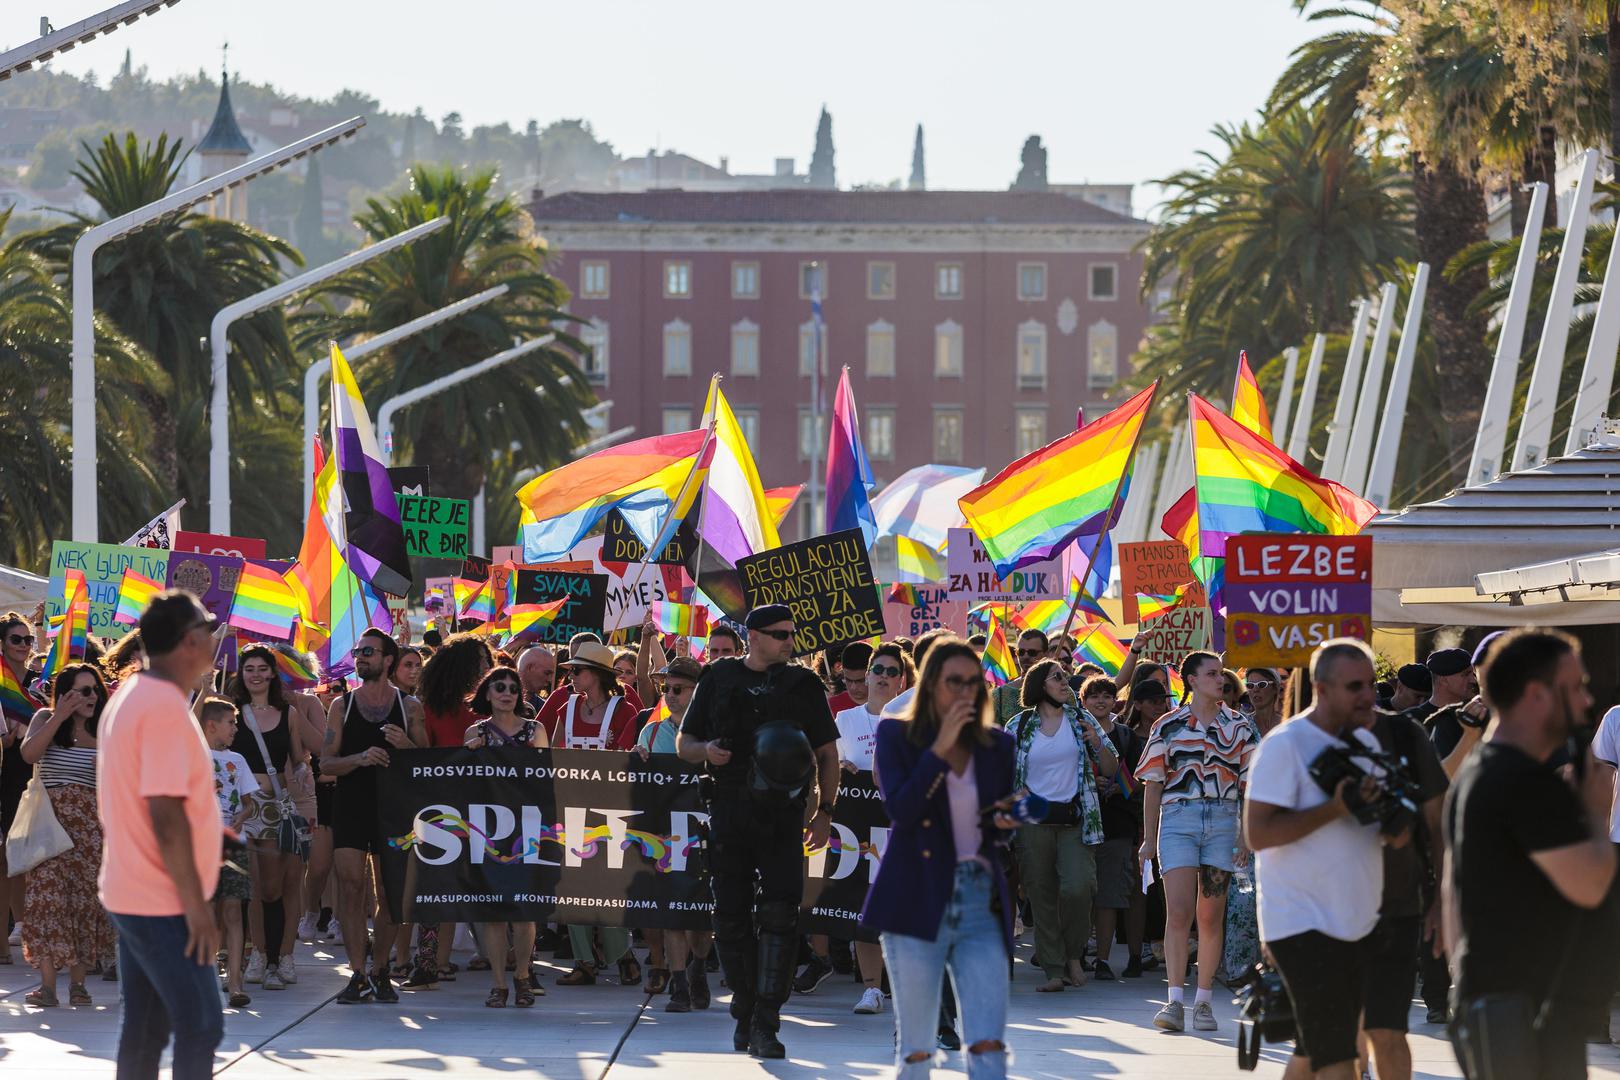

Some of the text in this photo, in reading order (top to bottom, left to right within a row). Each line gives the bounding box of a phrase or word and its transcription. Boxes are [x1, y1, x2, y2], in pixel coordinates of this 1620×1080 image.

[400, 499, 466, 525] EER JE
[745, 538, 860, 587] REGULACIJU
[1237, 544, 1367, 580] LEZBE,
[533, 574, 592, 597] SVAKA
[748, 562, 871, 609] ZDRAVSTVENE
[949, 571, 1060, 594] ZA HAJDUKA
[826, 590, 856, 616] ZA
[1249, 588, 1338, 615] VOLIN
[819, 609, 885, 643] OSOBE
[412, 765, 518, 778] PROSVJEDNA
[525, 767, 601, 781] POVORKA
[608, 771, 673, 785] LGBTIQ+
[680, 774, 700, 785] ZA
[413, 804, 644, 869] SPLIT
[416, 894, 503, 903] #MASUPONOSNI
[514, 894, 658, 909] #KONTRAPREDRASUDAMA
